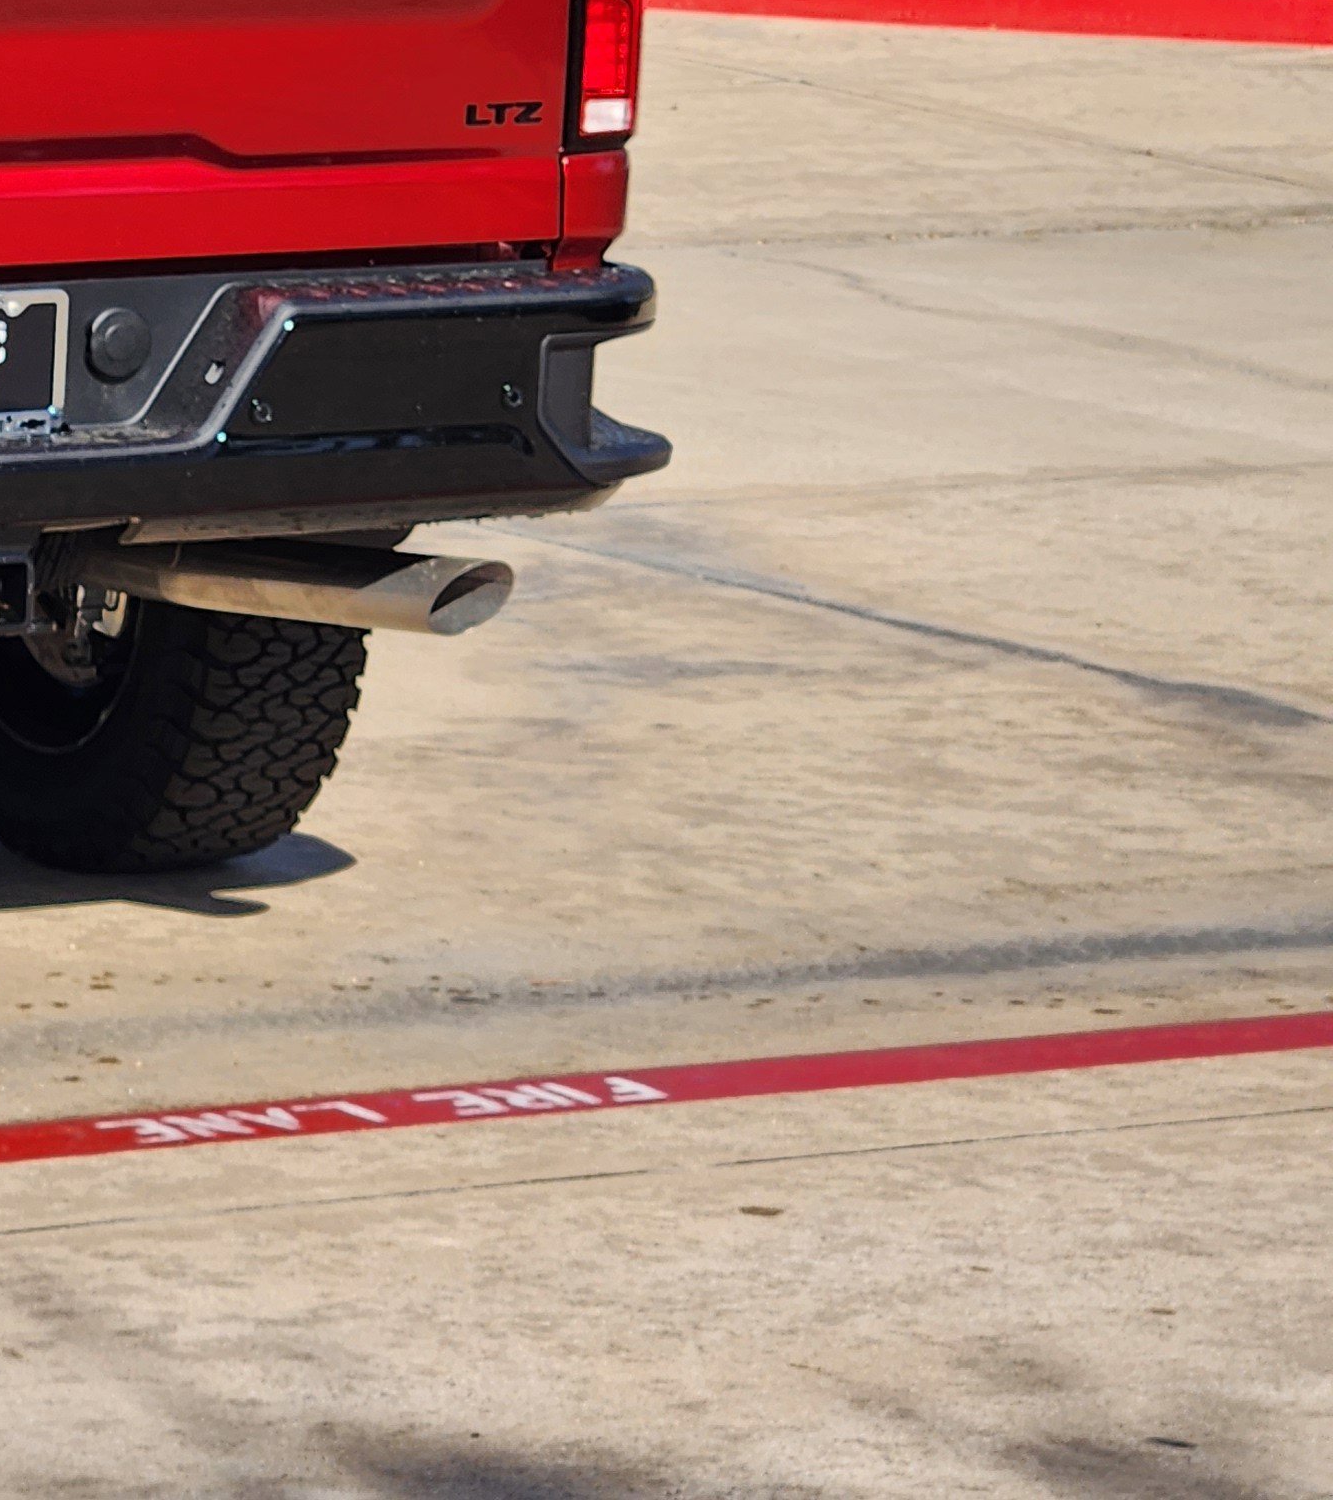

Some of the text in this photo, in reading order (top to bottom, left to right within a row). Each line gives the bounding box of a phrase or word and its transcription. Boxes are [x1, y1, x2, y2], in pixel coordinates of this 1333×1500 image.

[465, 101, 543, 126] LTZ
[411, 1076, 669, 1117] FIRE
[95, 1100, 388, 1144] LANE
